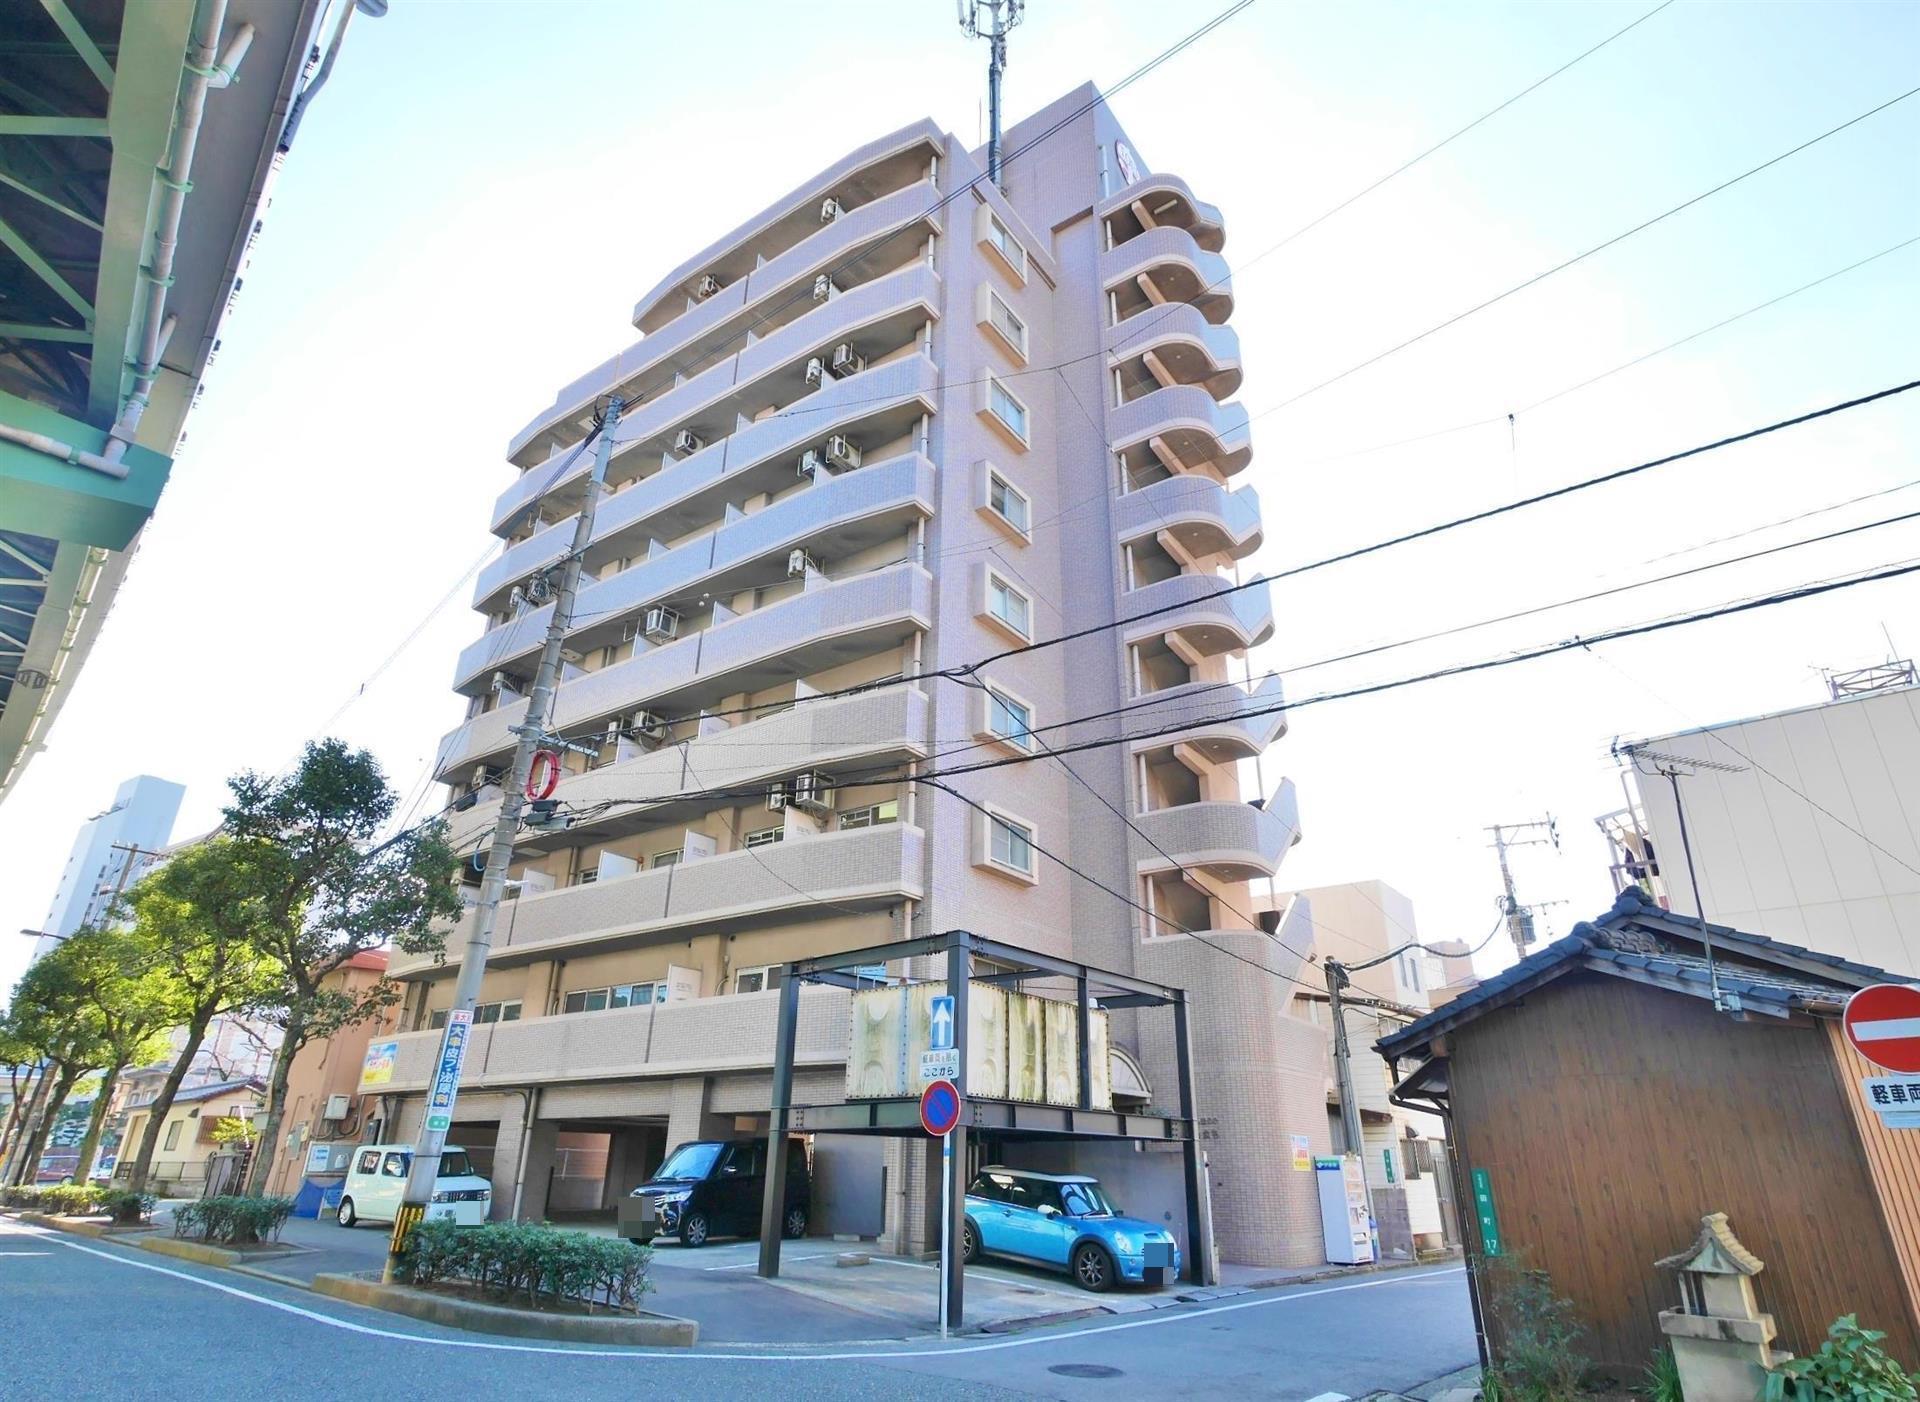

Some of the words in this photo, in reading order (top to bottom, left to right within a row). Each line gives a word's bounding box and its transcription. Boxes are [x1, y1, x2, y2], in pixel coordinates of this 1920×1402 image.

[924, 1066, 954, 1077] ここから
[1870, 1083, 1920, 1105] 軽車両
[1485, 1239, 1497, 1249] 17
